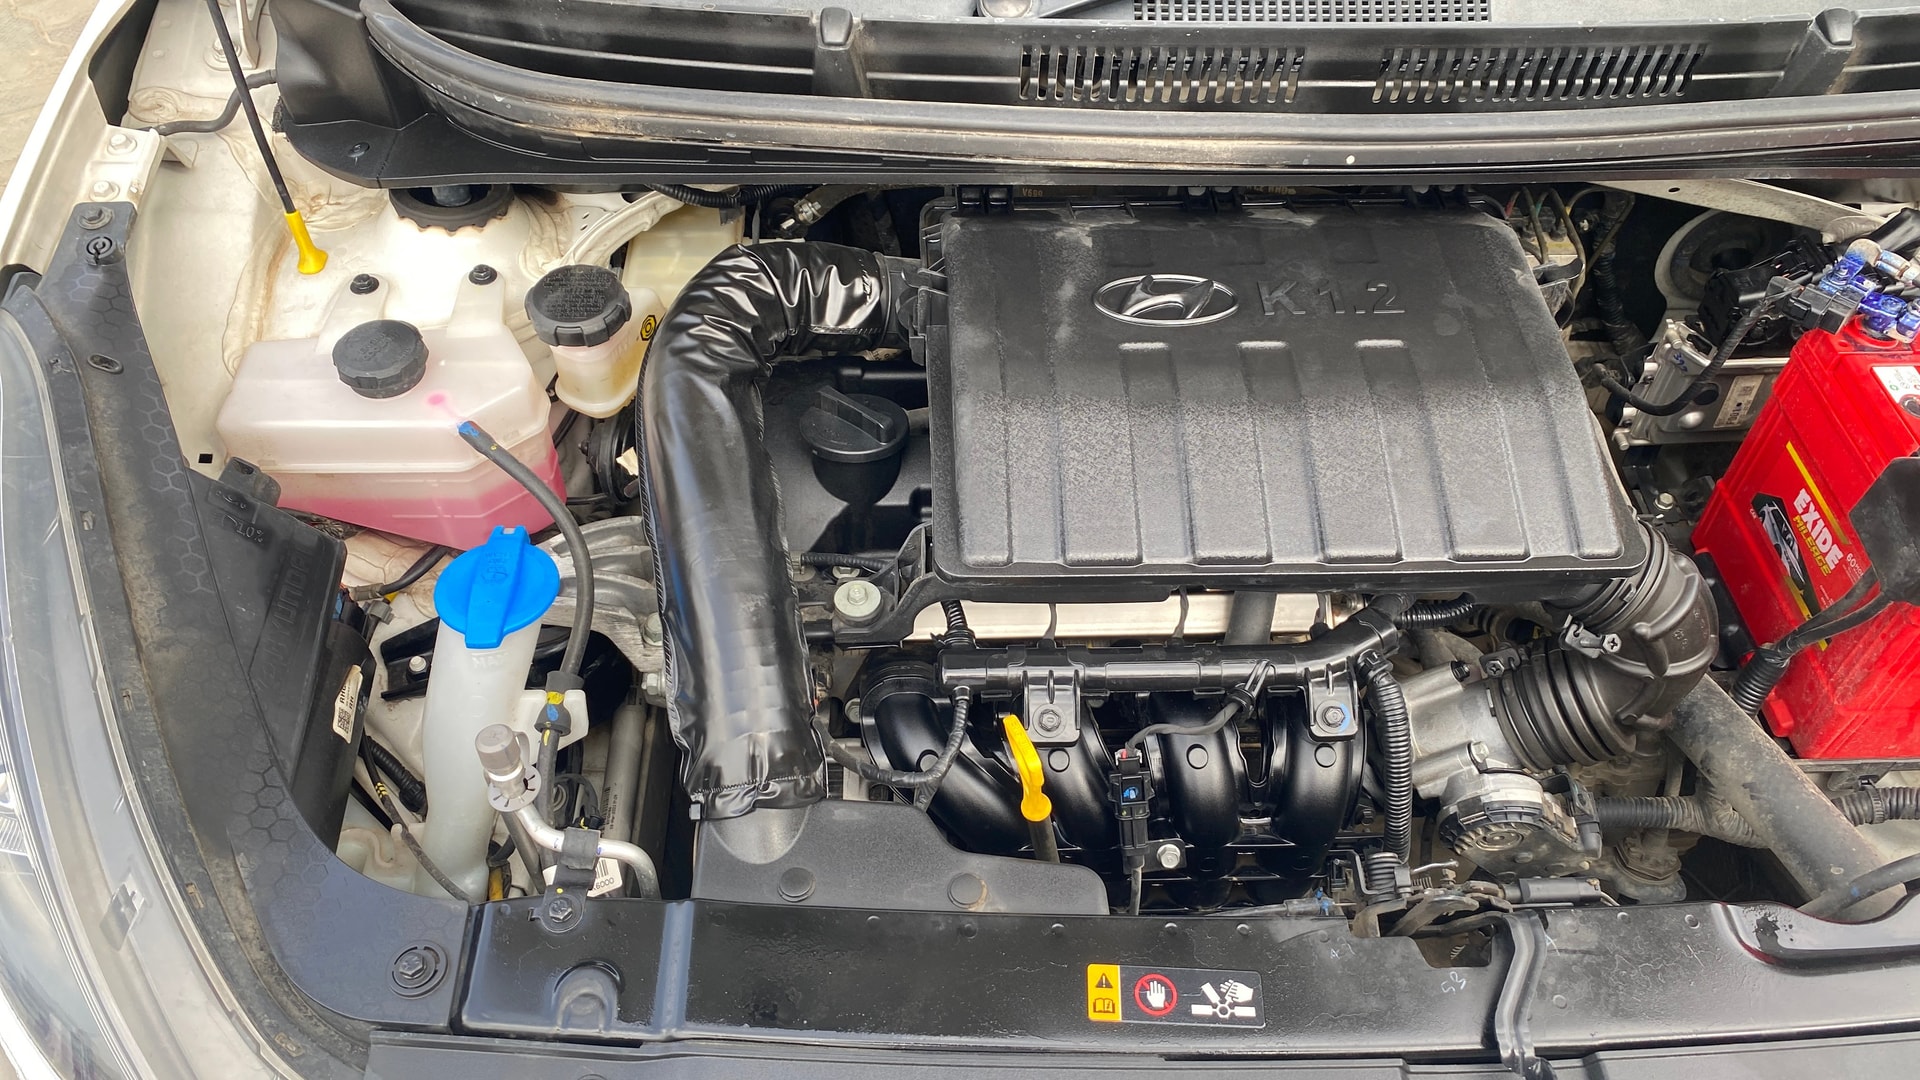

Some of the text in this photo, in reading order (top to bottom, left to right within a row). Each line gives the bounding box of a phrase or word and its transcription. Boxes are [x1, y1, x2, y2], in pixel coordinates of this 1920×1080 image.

[1793, 488, 1844, 570] EXIDE
[1793, 514, 1832, 577] MILEAGE
[593, 877, 615, 891] 6000
